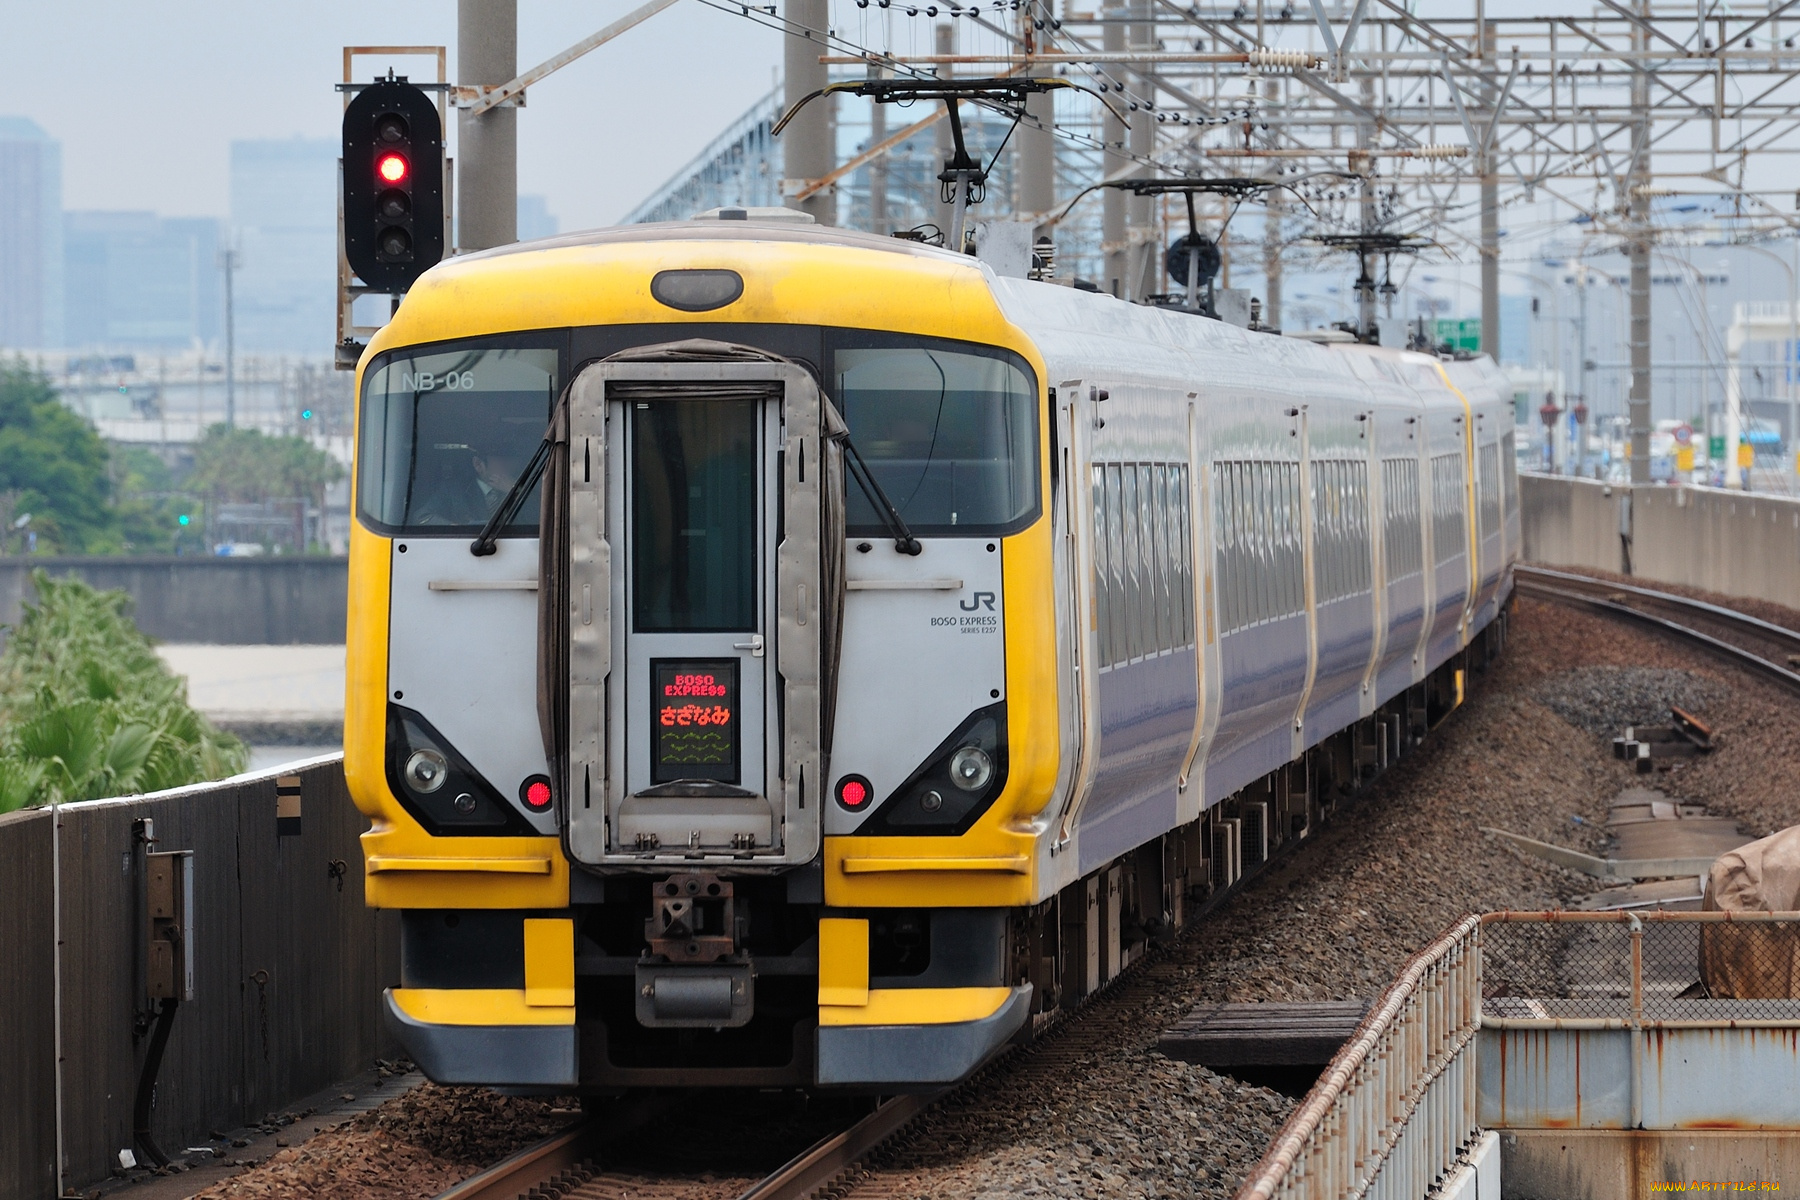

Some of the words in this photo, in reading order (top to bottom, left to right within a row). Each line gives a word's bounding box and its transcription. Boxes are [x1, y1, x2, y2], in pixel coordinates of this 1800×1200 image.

[402, 371, 474, 391] NB-06
[960, 592, 996, 611] JR
[931, 617, 957, 626] BOSO
[960, 616, 997, 626] EXPRESS
[675, 674, 715, 686] BOSO
[664, 685, 726, 697] EXPRESS
[660, 704, 730, 726] さざなみ
